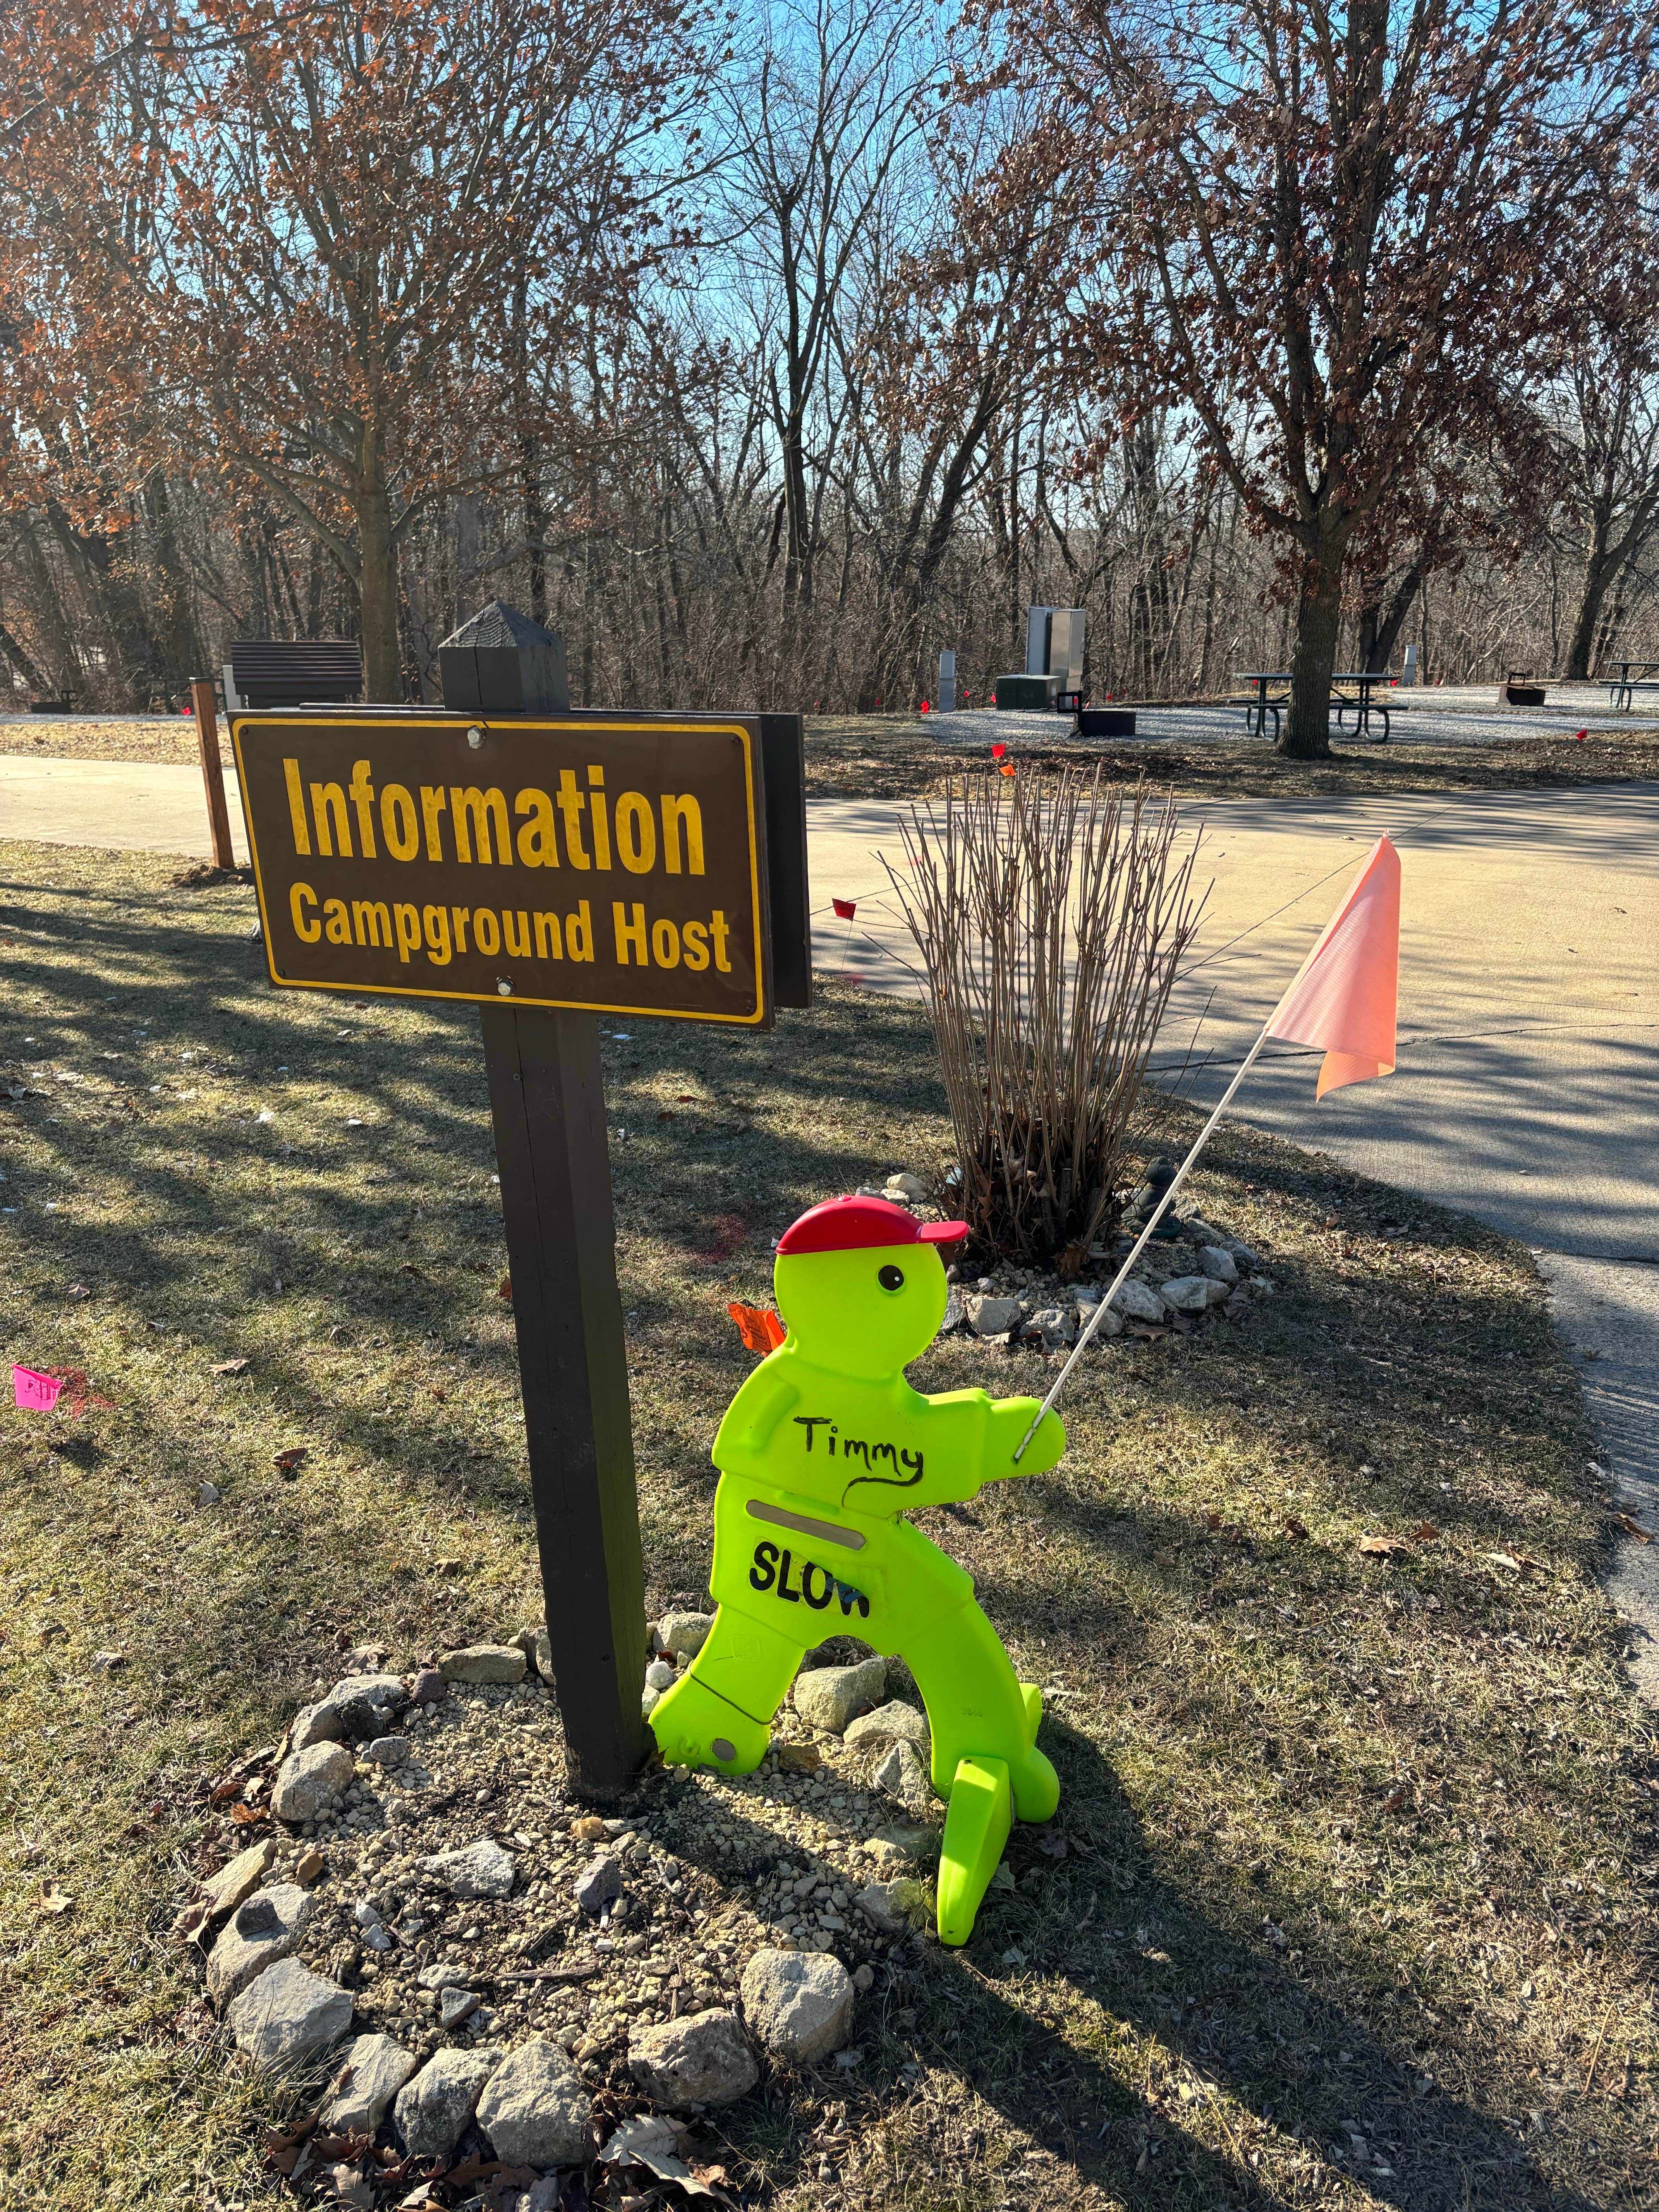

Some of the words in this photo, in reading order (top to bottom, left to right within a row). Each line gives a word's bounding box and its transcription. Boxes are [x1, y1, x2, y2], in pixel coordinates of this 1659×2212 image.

[283, 758, 705, 876] Information
[289, 882, 595, 965] Campground
[612, 901, 732, 973] Host
[792, 1416, 924, 1508] Timmy
